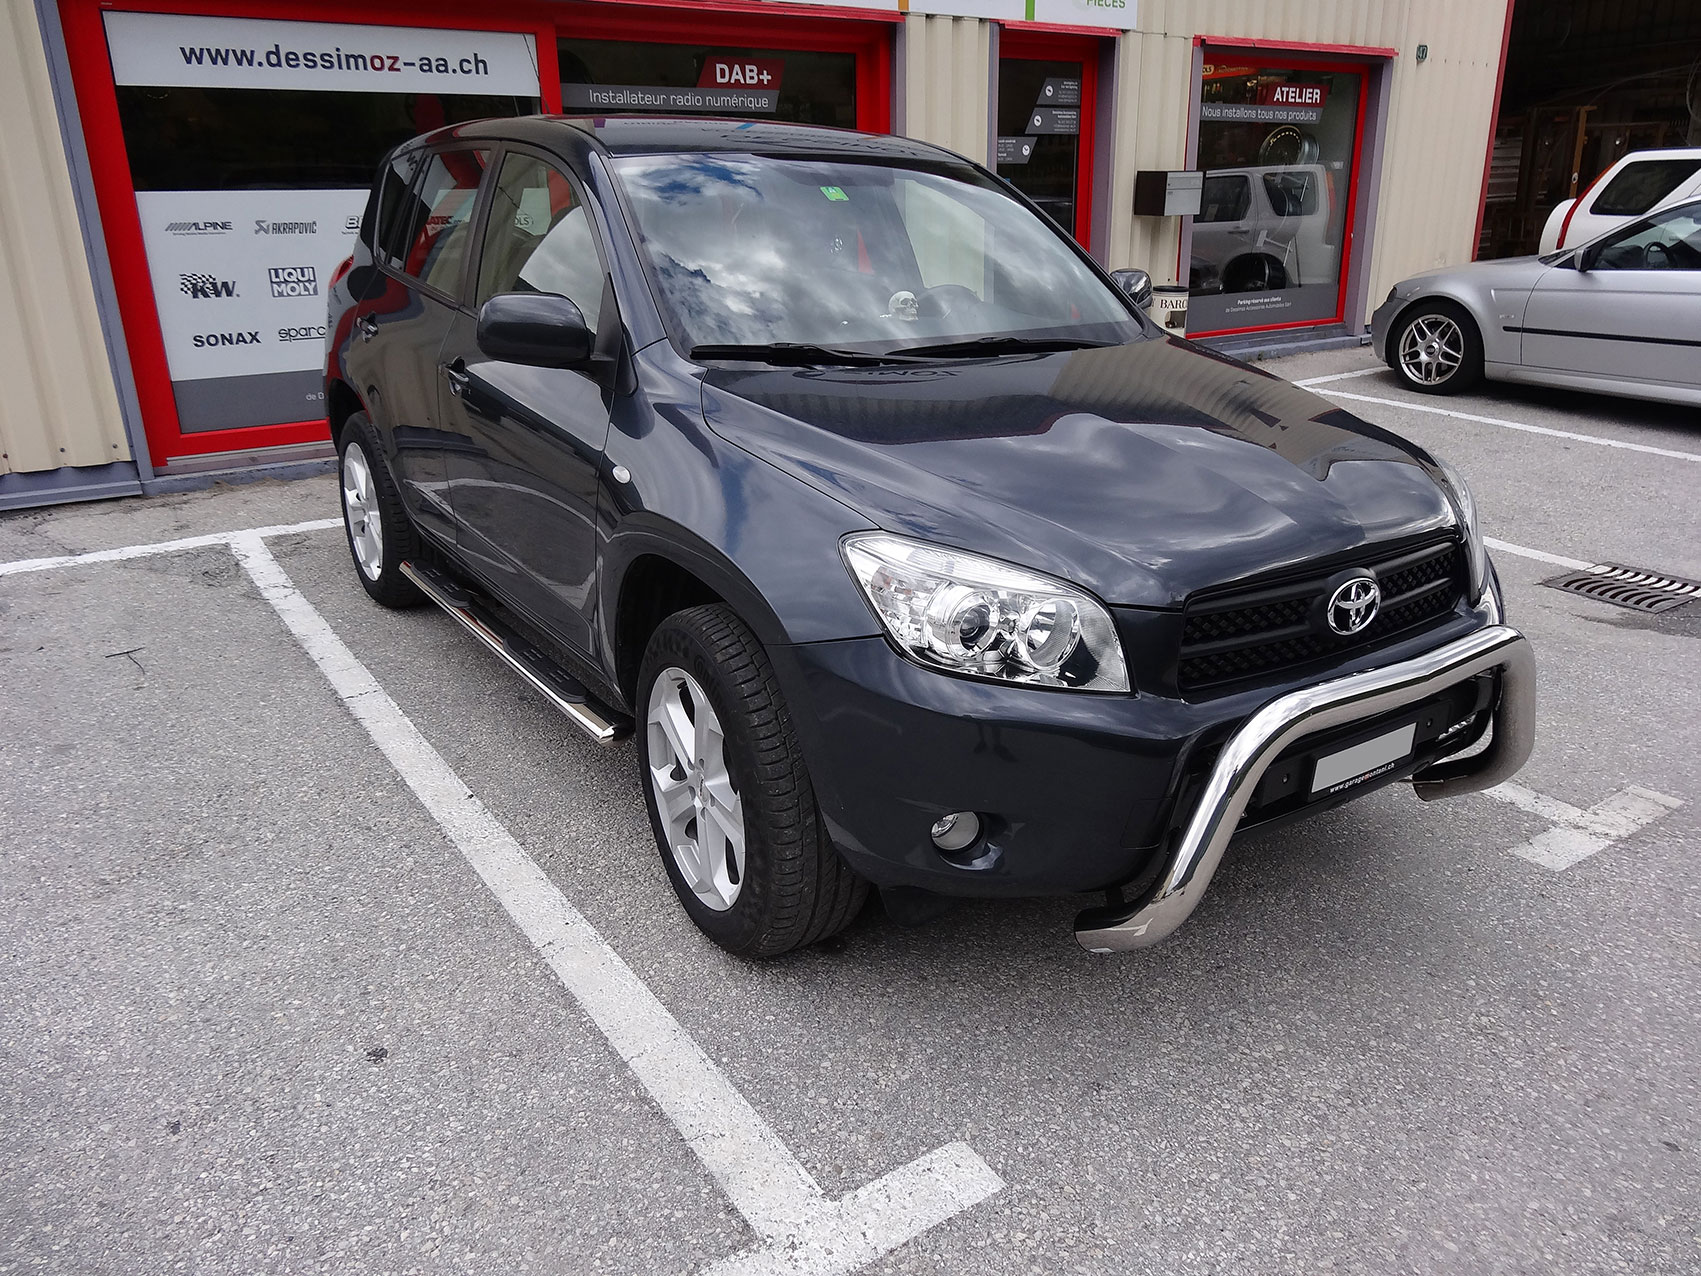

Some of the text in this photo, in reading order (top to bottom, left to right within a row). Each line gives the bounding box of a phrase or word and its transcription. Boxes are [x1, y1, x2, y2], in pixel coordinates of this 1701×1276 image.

[179, 43, 490, 76] www.dessimoz-aa.ch
[715, 63, 772, 85] DAB+
[589, 89, 769, 110] Installateur radio numérique
[1273, 86, 1321, 104] ATELIER
[1202, 106, 1317, 122] Nous installons tous nos produits
[187, 221, 233, 231] ALPINE
[270, 268, 314, 281] LIQUI
[272, 283, 317, 296] MOLY
[193, 331, 262, 348] SONAX
[305, 392, 317, 400] de
